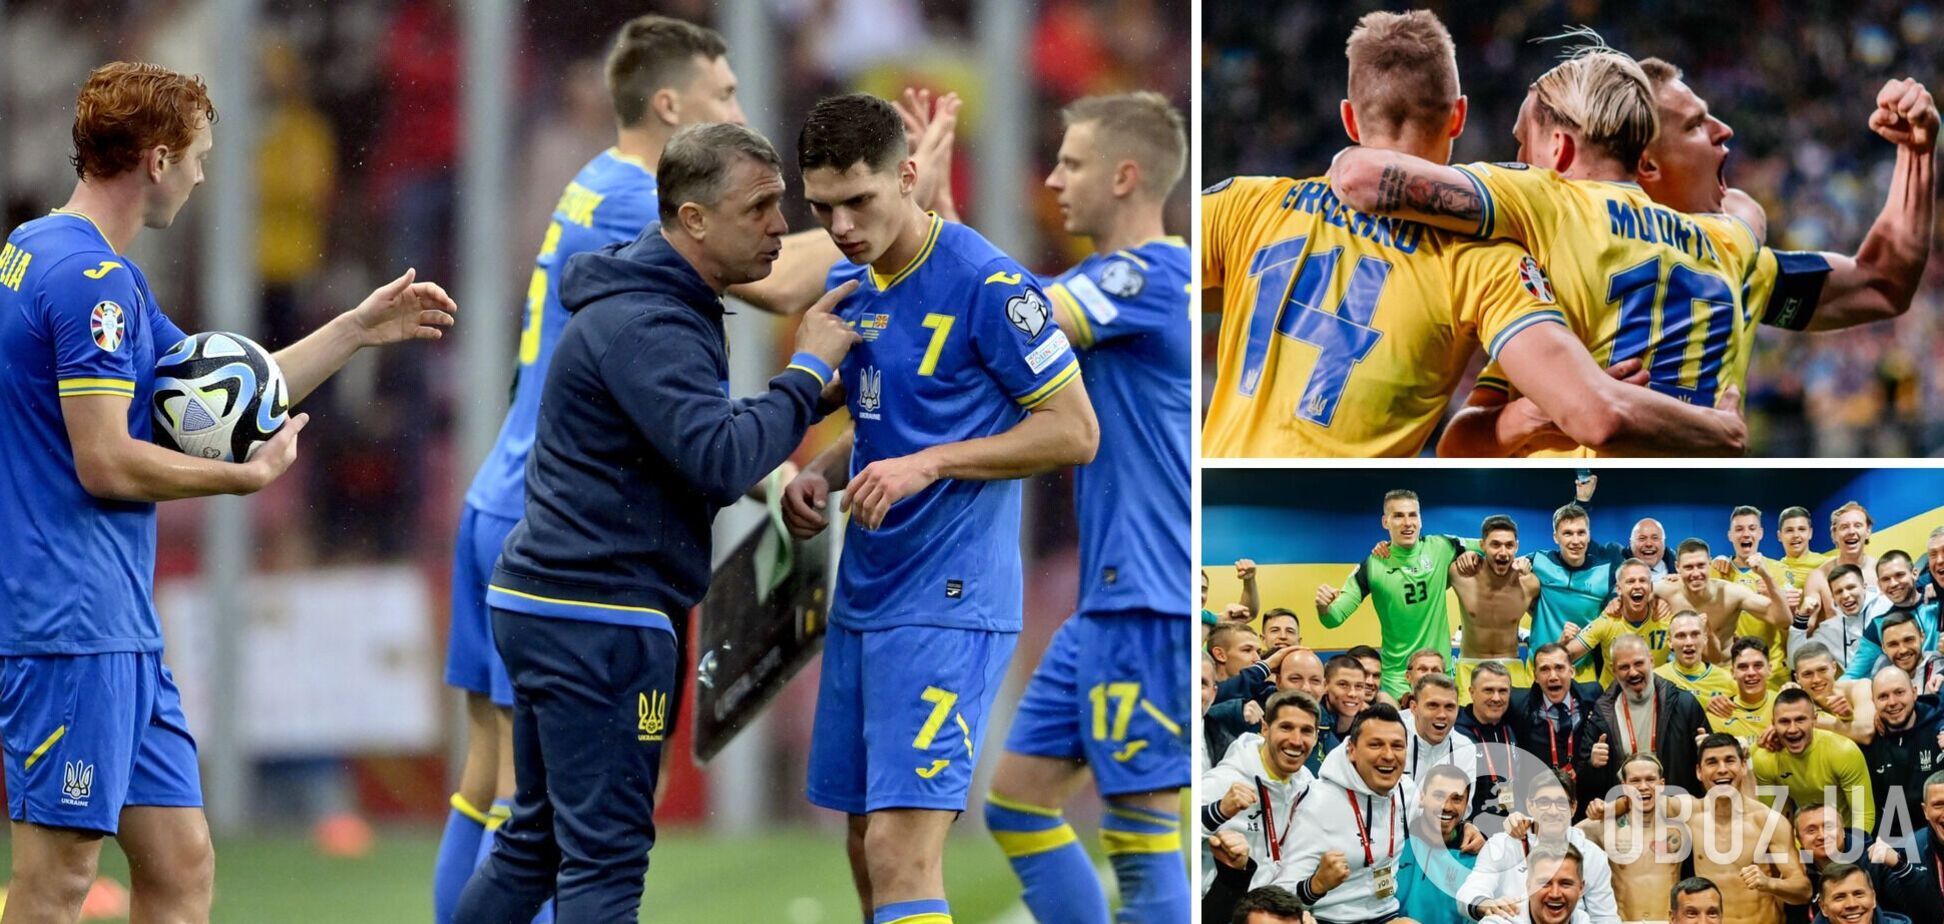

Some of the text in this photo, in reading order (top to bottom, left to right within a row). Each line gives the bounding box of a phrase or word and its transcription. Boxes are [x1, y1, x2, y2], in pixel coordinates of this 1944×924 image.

[918, 313, 956, 376] 7
[1238, 234, 1393, 427] 14
[1607, 255, 1736, 409] 10
[1404, 581, 1428, 605] 23
[1649, 630, 1666, 650] 17
[912, 685, 958, 750] 7
[1089, 683, 1141, 741] 17
[61, 798, 89, 807] UKRAINE
